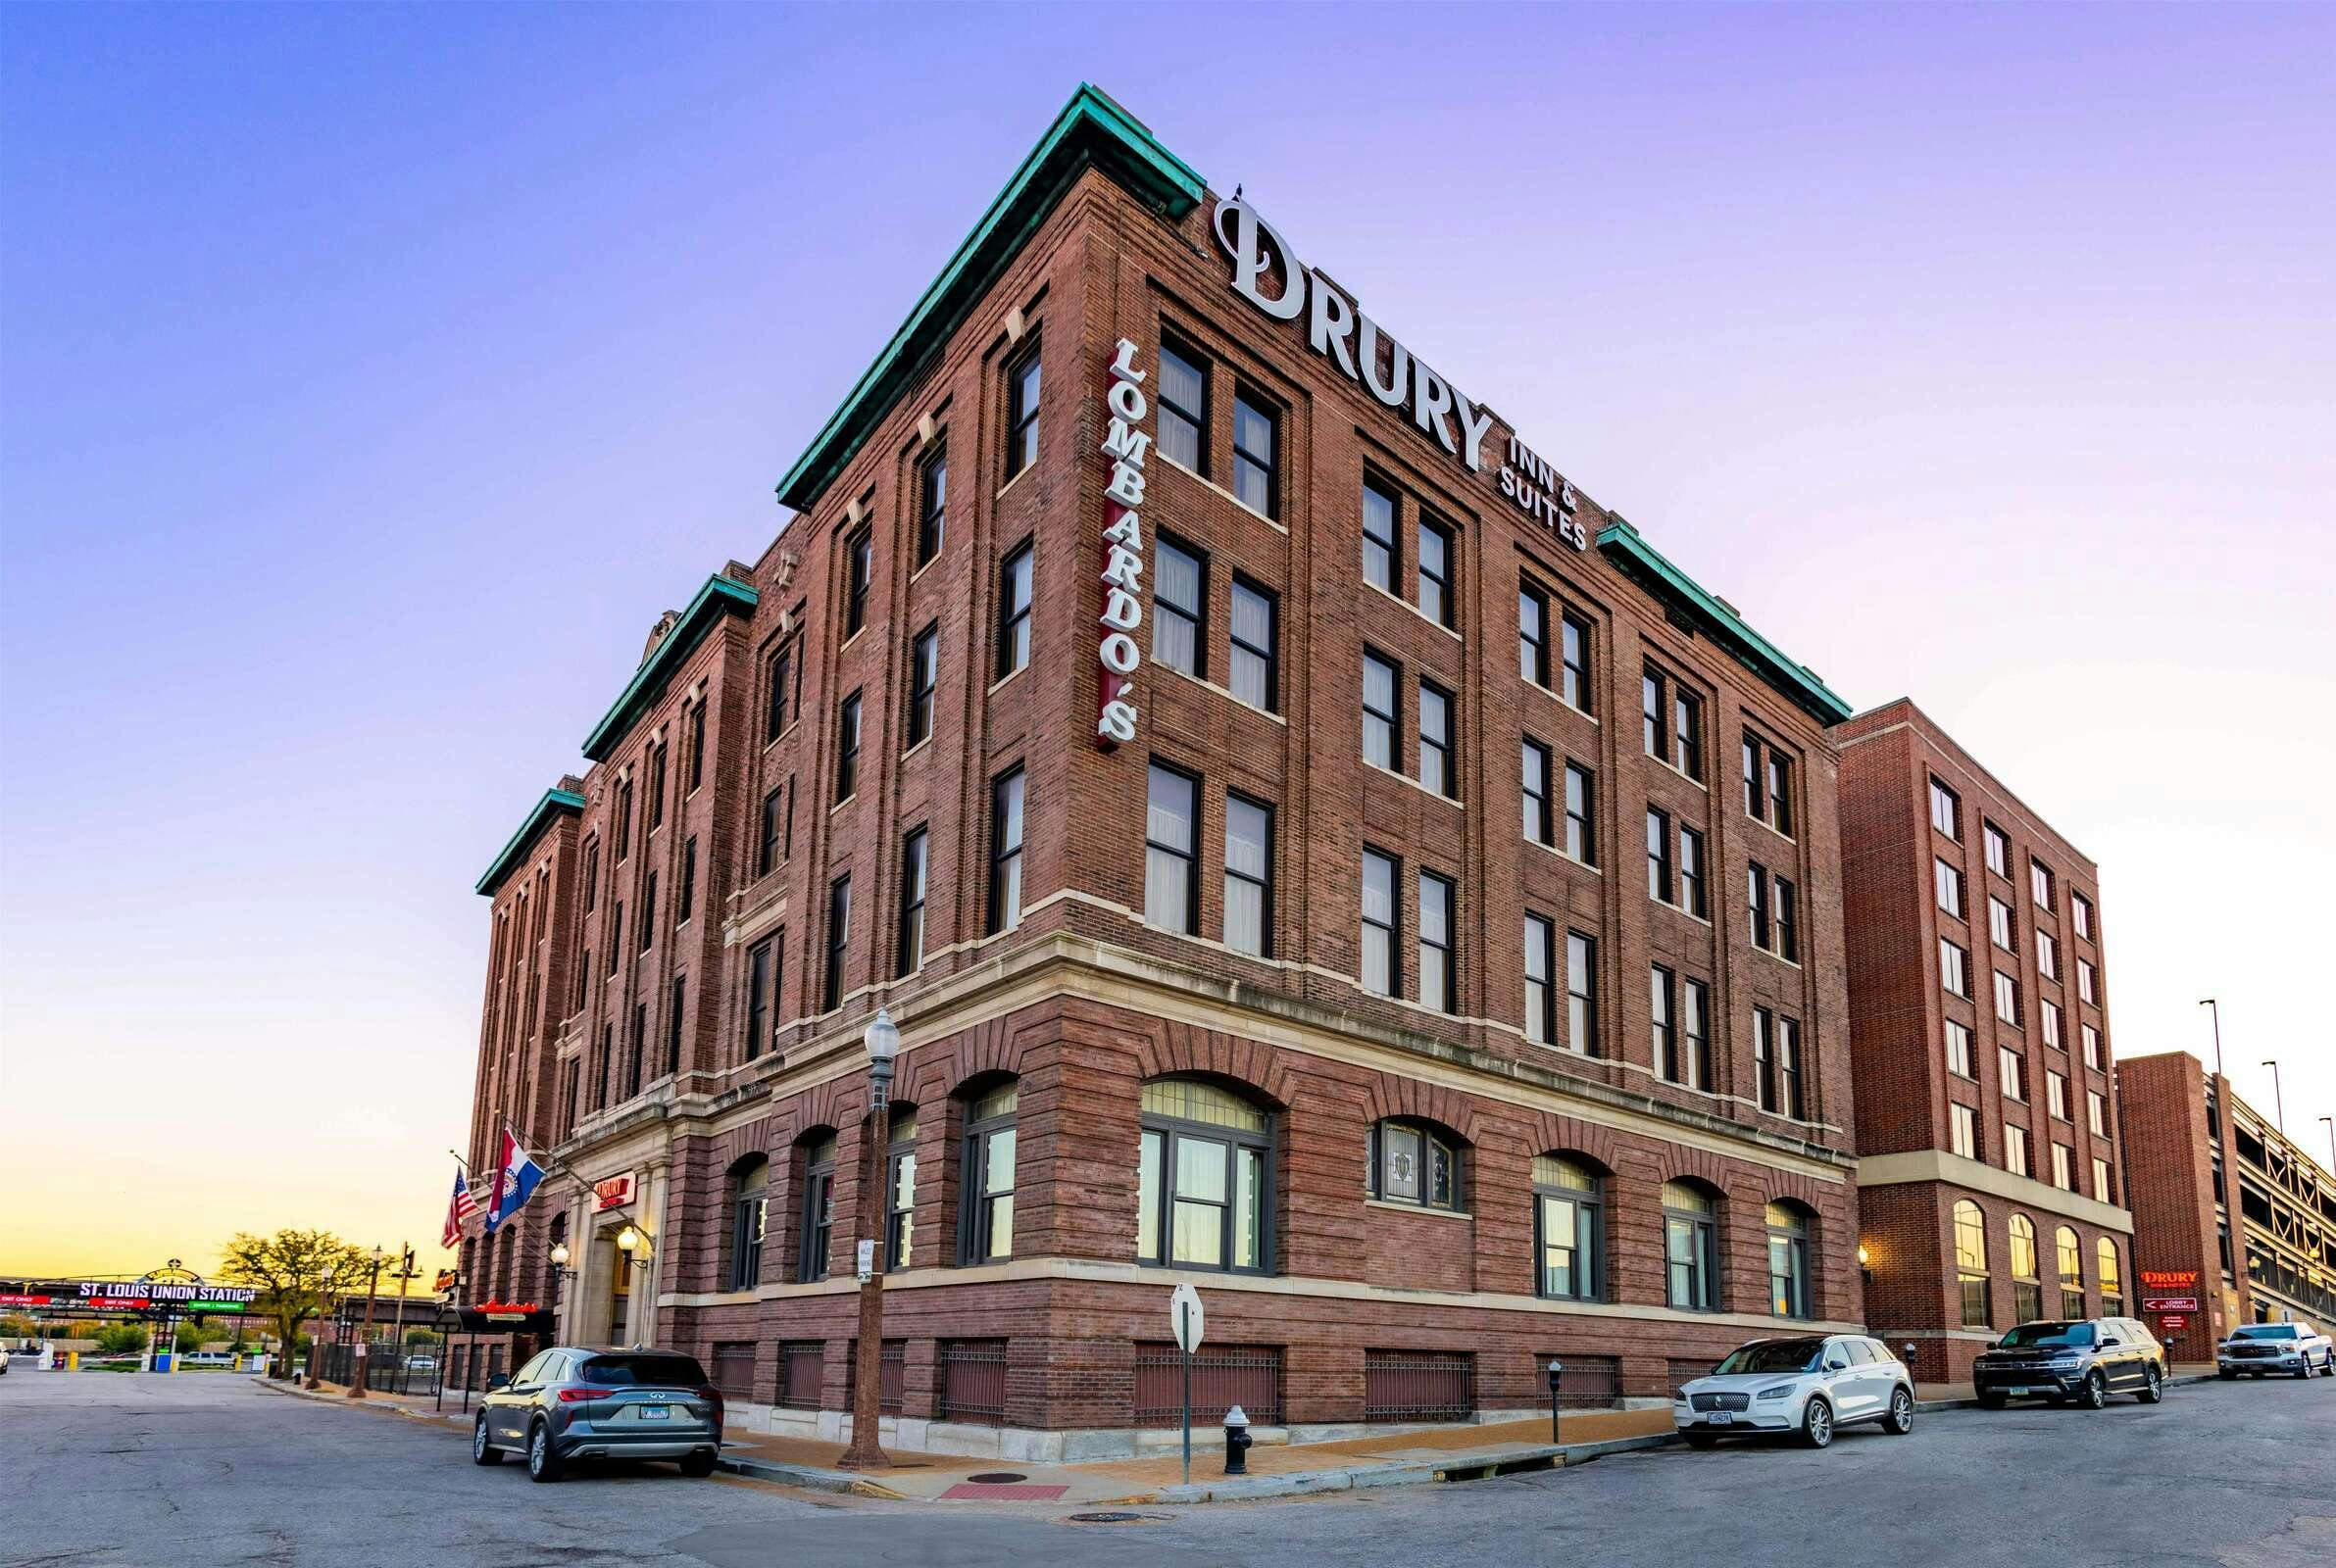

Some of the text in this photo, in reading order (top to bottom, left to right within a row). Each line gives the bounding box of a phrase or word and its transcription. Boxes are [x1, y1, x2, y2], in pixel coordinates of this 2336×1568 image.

[1214, 196, 1493, 472] DRURY
[1500, 466, 1586, 551] SUITES
[1511, 435, 1577, 513] INN &
[1099, 337, 1152, 743] LOMBARDO'S
[79, 1283, 255, 1302] ST. LOUIS UNION STATION
[2140, 1272, 2196, 1283] DRURY
